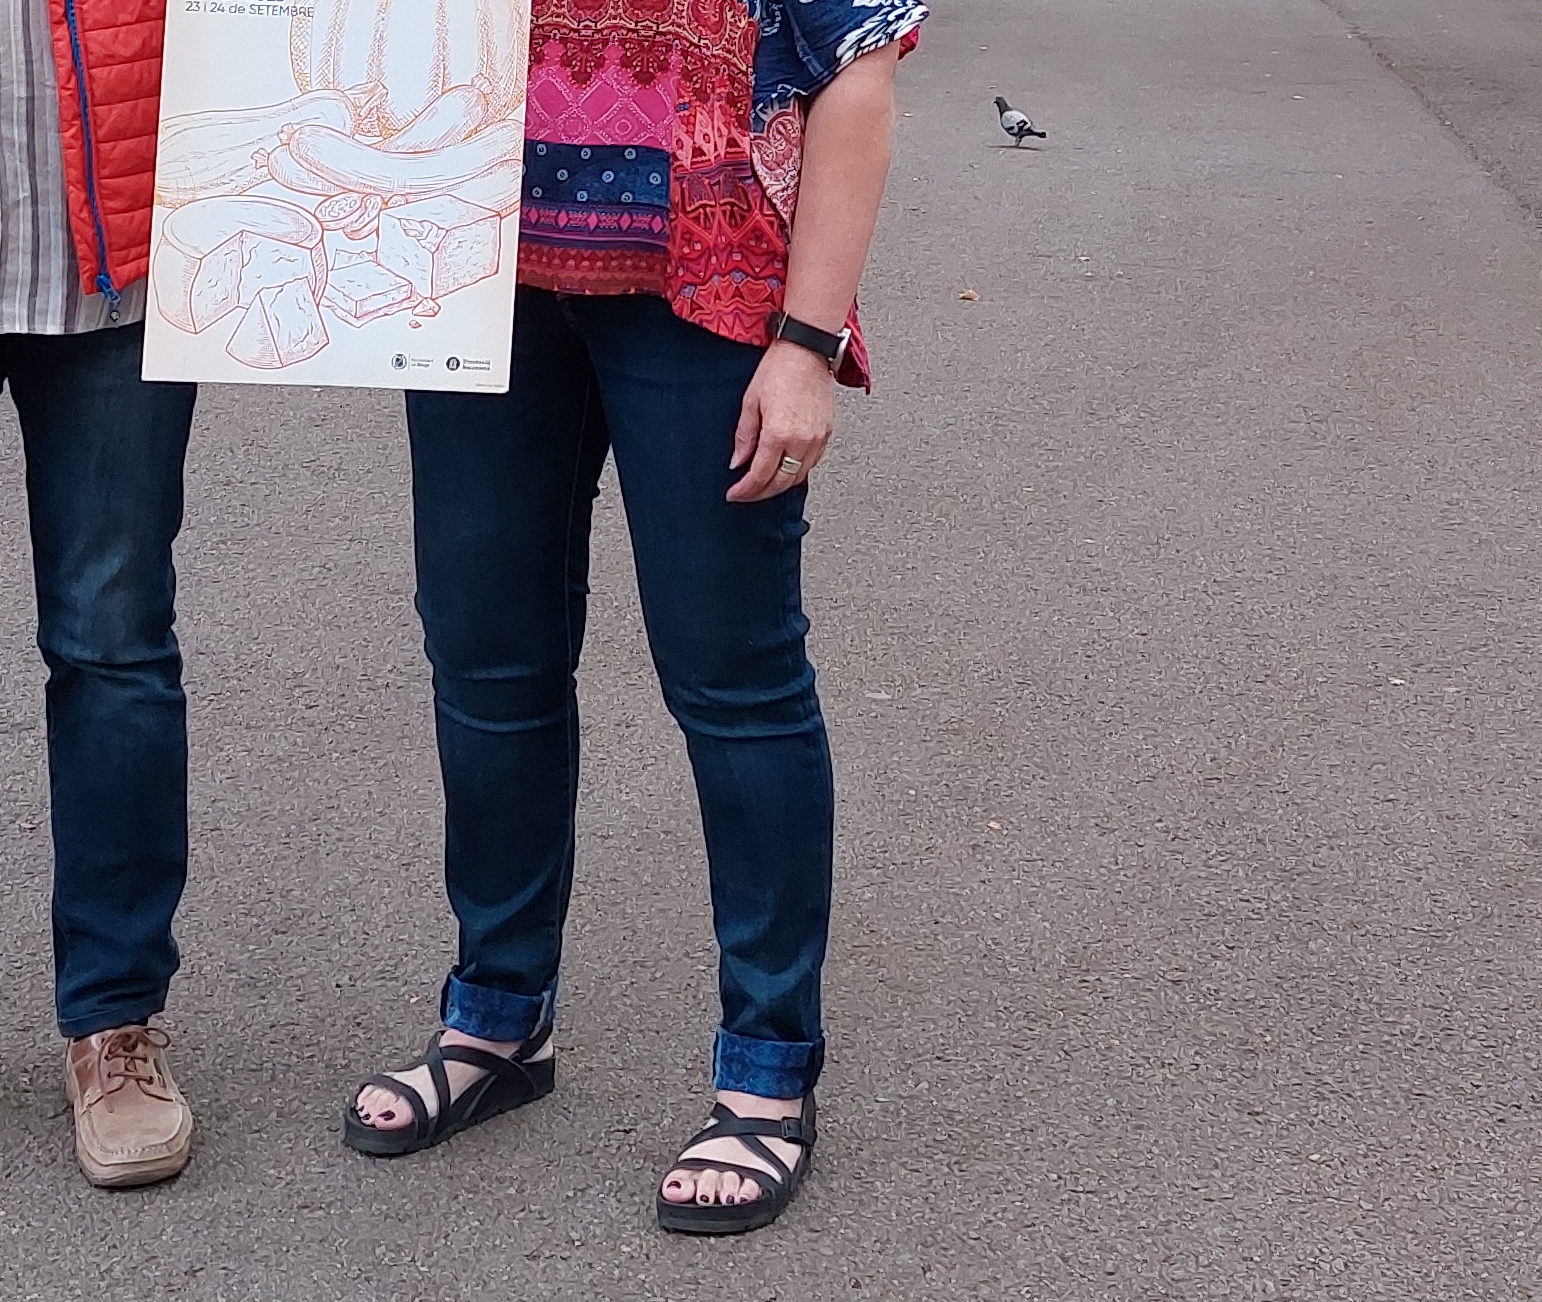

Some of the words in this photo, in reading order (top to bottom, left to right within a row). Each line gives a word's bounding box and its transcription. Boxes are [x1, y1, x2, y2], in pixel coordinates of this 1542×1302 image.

[185, 1, 201, 12] 23
[209, 2, 225, 13] 24
[228, 4, 246, 14] de
[248, 4, 316, 18] SETEMBRE
